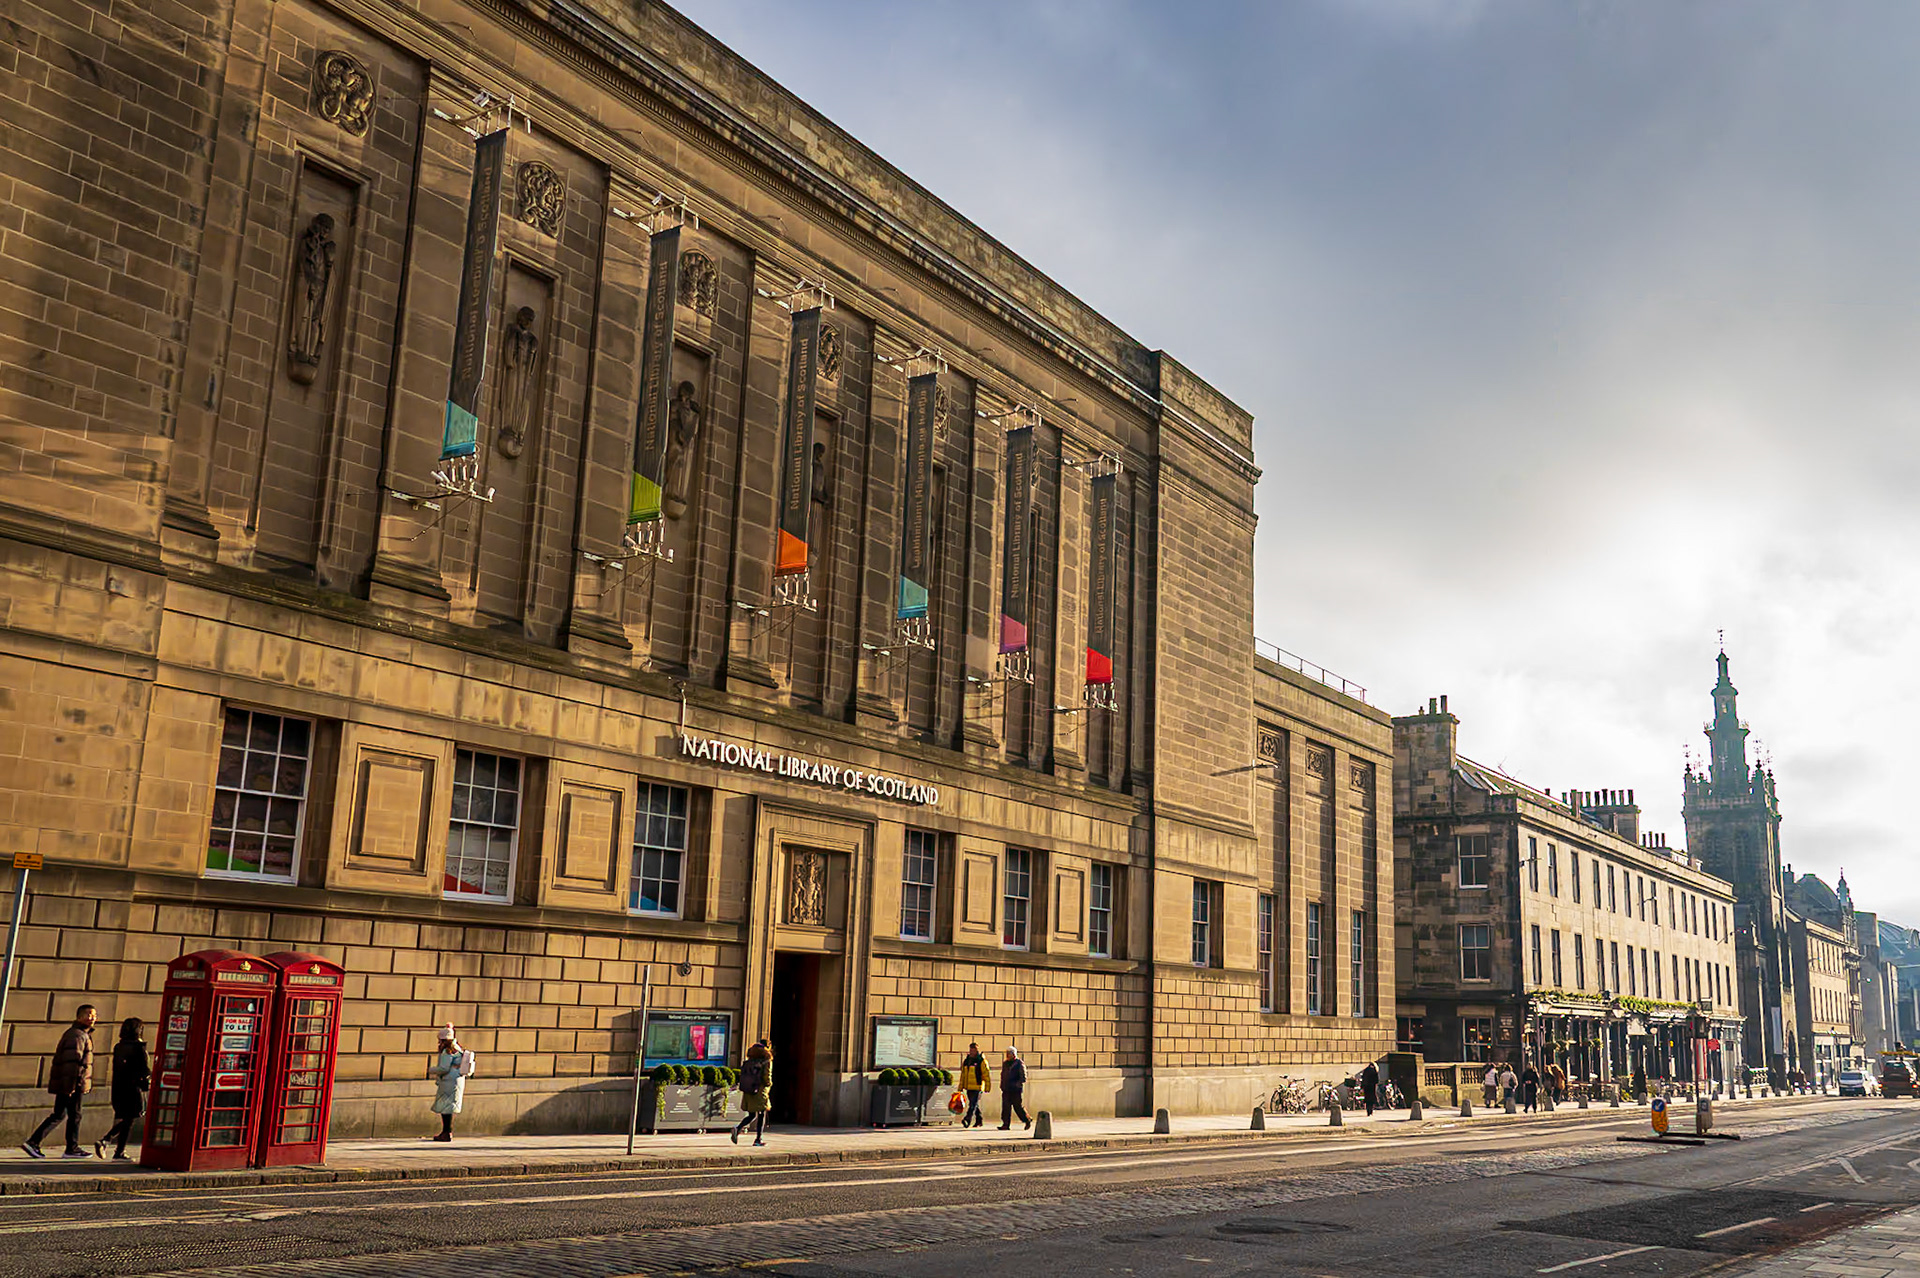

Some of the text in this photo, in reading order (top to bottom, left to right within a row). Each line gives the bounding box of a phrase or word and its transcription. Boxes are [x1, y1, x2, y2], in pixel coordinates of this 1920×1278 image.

[478, 167, 492, 230] Scotland
[645, 261, 668, 451] National Library of Scotland
[790, 338, 809, 510] National Library of Scotland
[1010, 452, 1023, 598] National Library of Scotland
[1098, 498, 1107, 541] Scotland
[1096, 556, 1107, 589] Library
[1095, 592, 1104, 633] National
[682, 735, 939, 806] NATIONAL LIBRARY OF SCOTLAND
